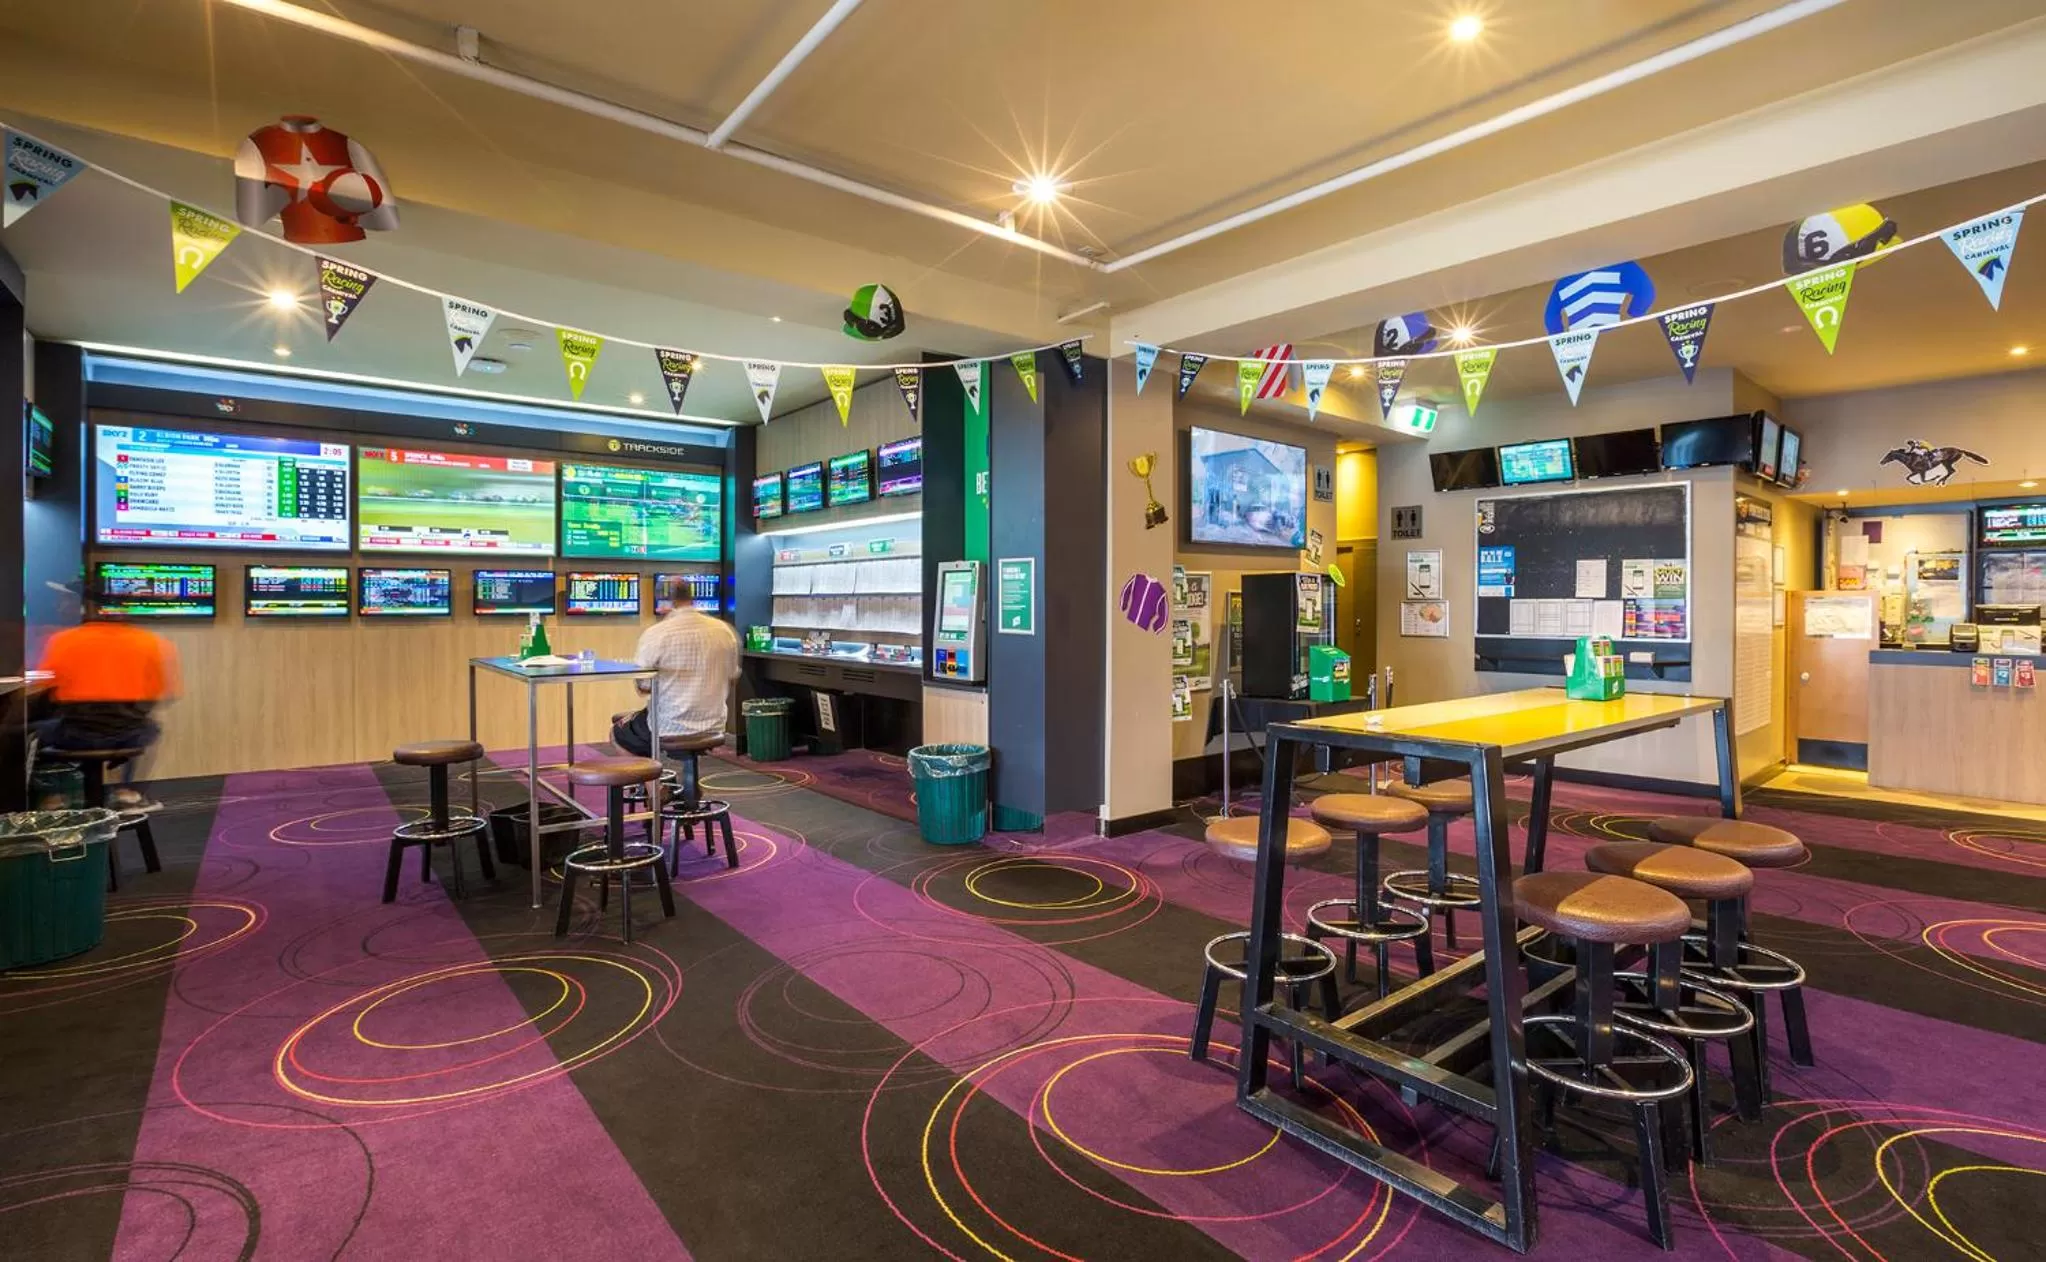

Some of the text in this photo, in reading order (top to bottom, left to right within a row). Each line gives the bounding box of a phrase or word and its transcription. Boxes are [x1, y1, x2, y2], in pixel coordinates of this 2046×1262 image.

[13, 136, 73, 168] SPRING
[10, 149, 66, 182] Racing
[178, 207, 230, 233] SPRING
[1953, 214, 2013, 241] SPRING
[1804, 230, 1829, 259] 6
[1957, 226, 2012, 254] Racing
[1964, 243, 2010, 260] CARNIVAL
[321, 260, 367, 282] SPRING
[1795, 269, 1846, 290] SPRING
[321, 269, 364, 294] Racing
[1799, 280, 1847, 303] Racing
[448, 301, 488, 319] SPRING
[879, 303, 890, 324] 3
[1664, 306, 1708, 323] SPRING
[1668, 318, 1707, 336] Racing
[562, 331, 597, 345] SPRING
[1386, 328, 1398, 347] 2
[1556, 333, 1592, 346] SPRING
[1670, 331, 1704, 342] CARNIVAL
[563, 339, 596, 356] Racing
[660, 351, 692, 361] SPRING
[748, 363, 776, 372] SPRING
[323, 447, 342, 456] 2:05
[623, 442, 684, 456] TRACKSIDE
[1315, 490, 1333, 500] TOILET
[1393, 528, 1421, 538] TOILET
